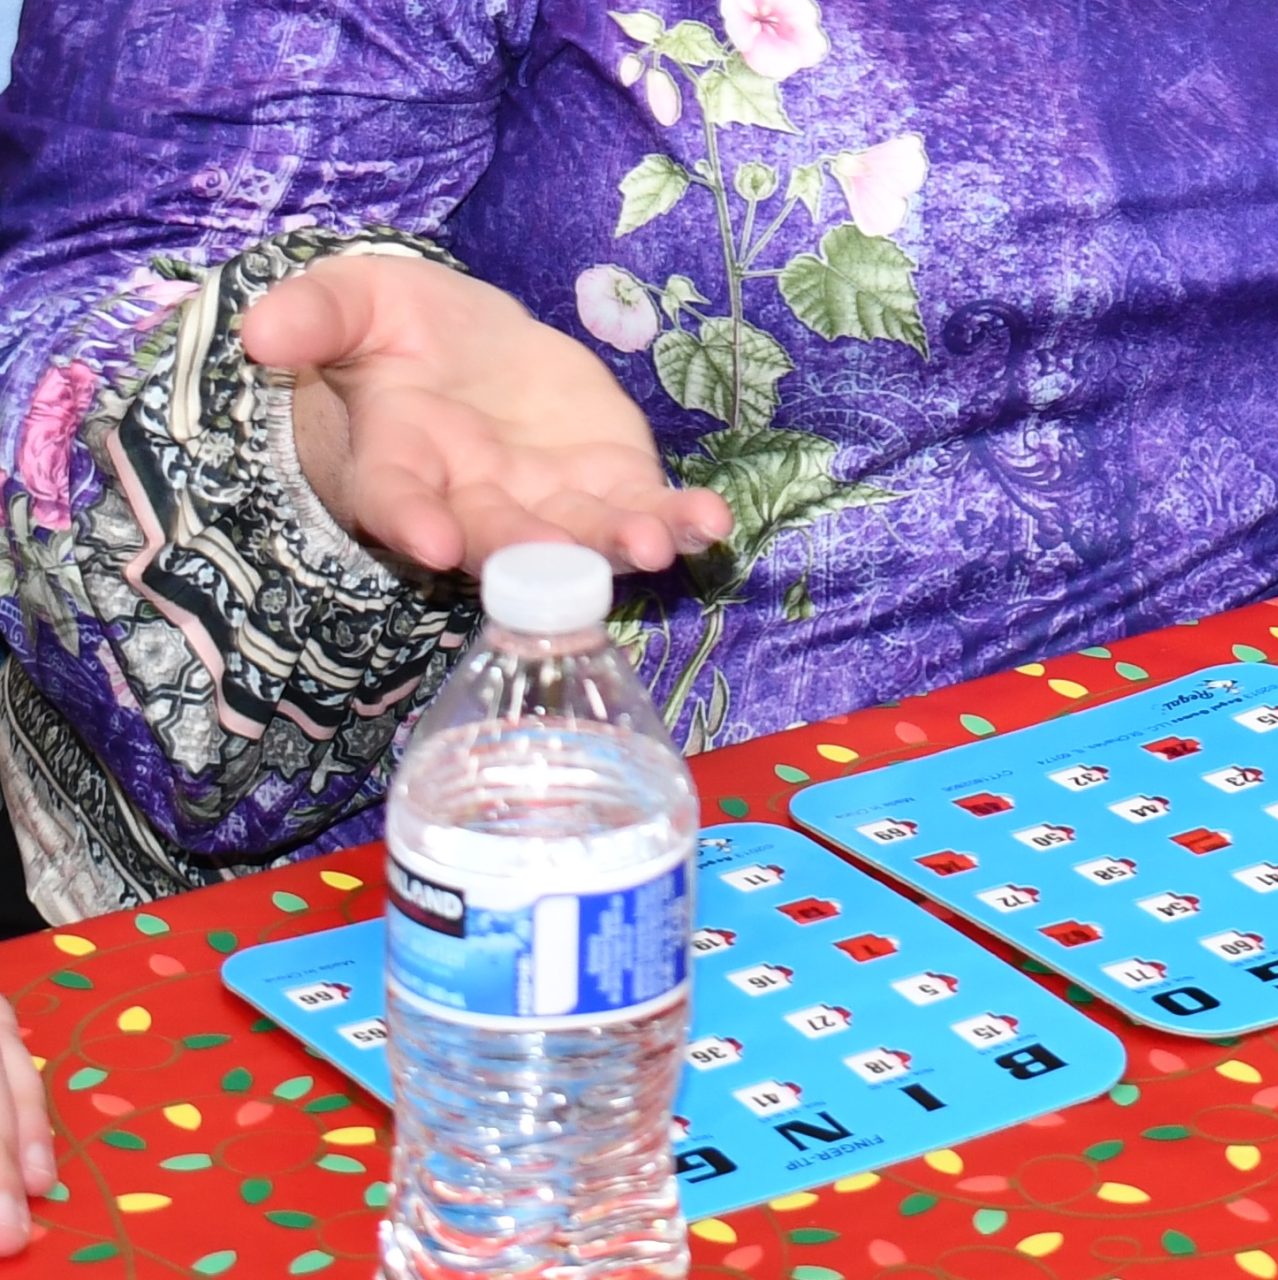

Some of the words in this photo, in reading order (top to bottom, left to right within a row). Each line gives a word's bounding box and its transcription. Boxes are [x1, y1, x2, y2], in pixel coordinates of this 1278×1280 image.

[1162, 690, 1214, 711] Regal
[1067, 772, 1102, 787] 32
[1226, 772, 1255, 787] 23
[1130, 804, 1158, 817] 44
[874, 828, 906, 841] 69
[1031, 833, 1063, 846] 50
[744, 875, 769, 886] 11
[1093, 866, 1126, 881] 58
[998, 894, 1028, 908] 72
[1156, 902, 1190, 917] 54
[692, 938, 721, 951] 19
[1220, 939, 1254, 955] 60
[748, 975, 777, 988] 16
[1125, 969, 1152, 982] 71
[300, 990, 333, 1004] 66
[918, 984, 939, 996] 5
[1151, 986, 1221, 1016] O
[807, 1015, 836, 1031] 27
[353, 1028, 387, 1042] 65
[973, 1024, 1003, 1039] 15
[690, 1046, 729, 1064] 36
[995, 1043, 1069, 1079] B
[864, 1059, 895, 1074] 18
[752, 1092, 780, 1108] 41
[900, 1083, 948, 1112] I
[773, 1111, 854, 1151] N
[786, 1134, 884, 1171] FINGER-TIP
[675, 1146, 738, 1183] G
